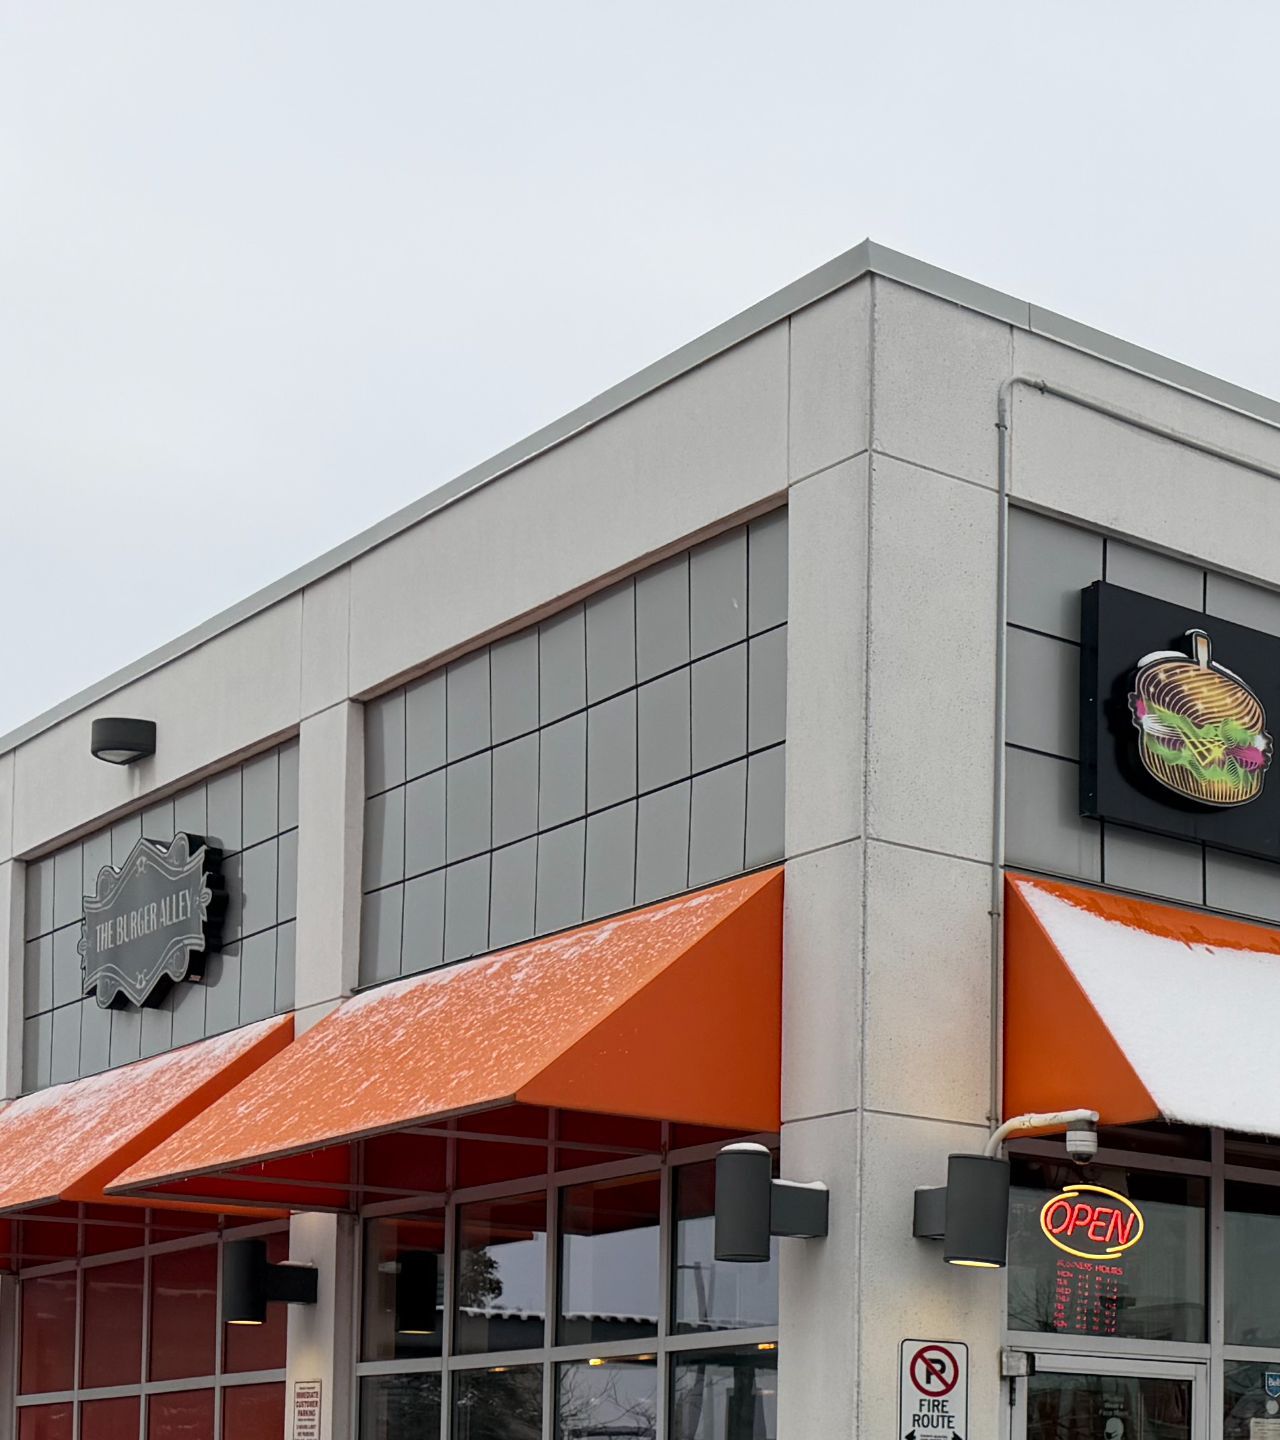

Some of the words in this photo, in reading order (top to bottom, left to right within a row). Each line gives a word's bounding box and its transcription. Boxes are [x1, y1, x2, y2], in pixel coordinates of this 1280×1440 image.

[96, 920, 114, 953] THE
[116, 902, 157, 946] BURGER
[159, 888, 193, 927] ALLEY
[1046, 1200, 1136, 1245] OPEN
[912, 1413, 955, 1429] ROUTE
[919, 1398, 949, 1414] FIRE
